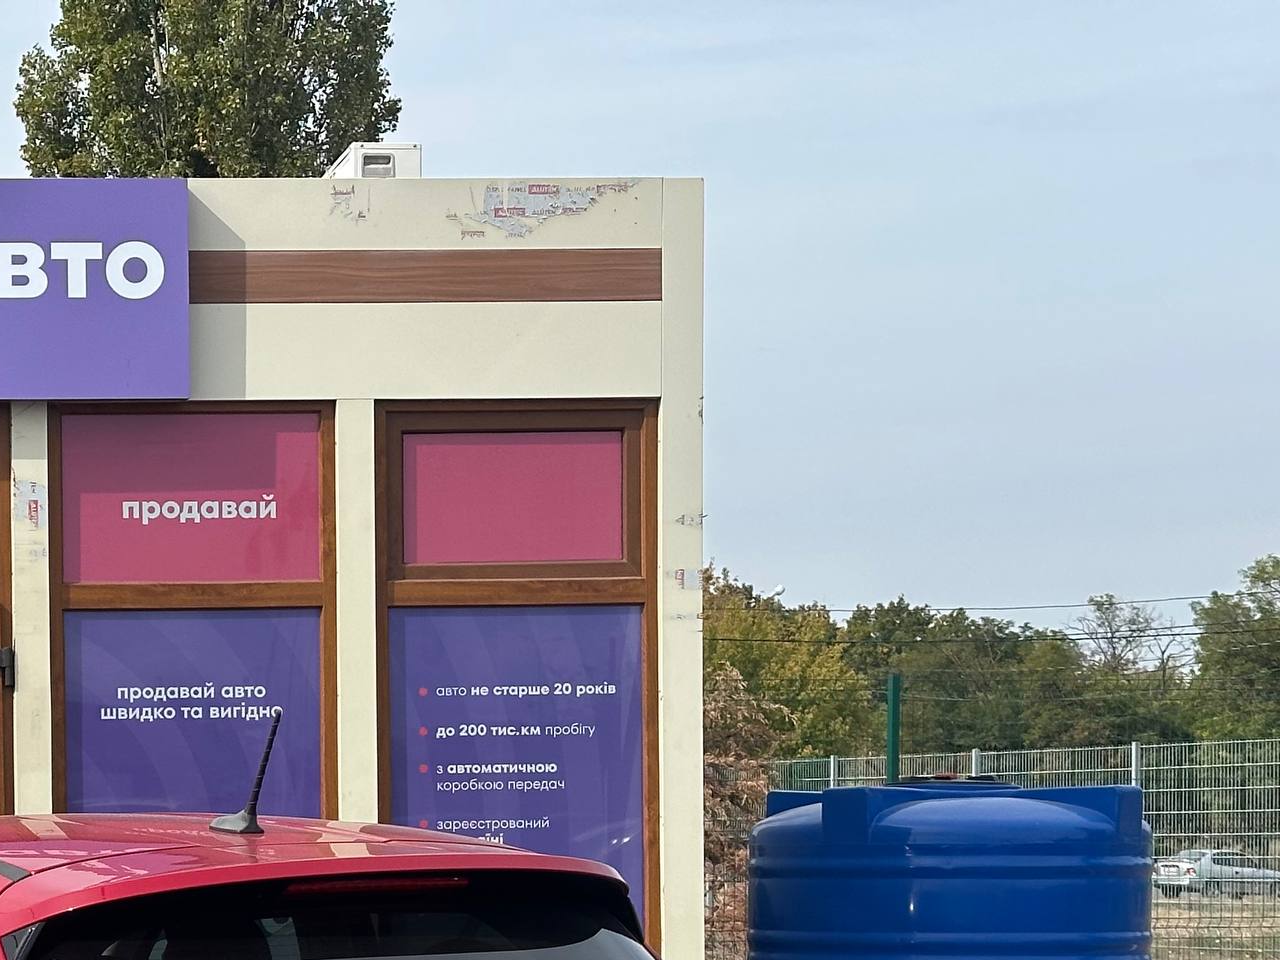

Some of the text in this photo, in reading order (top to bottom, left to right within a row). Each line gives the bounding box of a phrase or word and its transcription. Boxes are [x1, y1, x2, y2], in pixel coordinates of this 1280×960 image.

[122, 494, 277, 525] продавай
[117, 682, 266, 703] продавай авто
[436, 682, 616, 698] авто не старше 20 років
[100, 707, 176, 722] швидко
[181, 707, 203, 719] та
[436, 723, 596, 739] до 200 тис.км пробігу
[436, 762, 558, 774] з автоматичною
[436, 779, 565, 793] коробкою передач
[436, 817, 550, 832] зареєстрований
